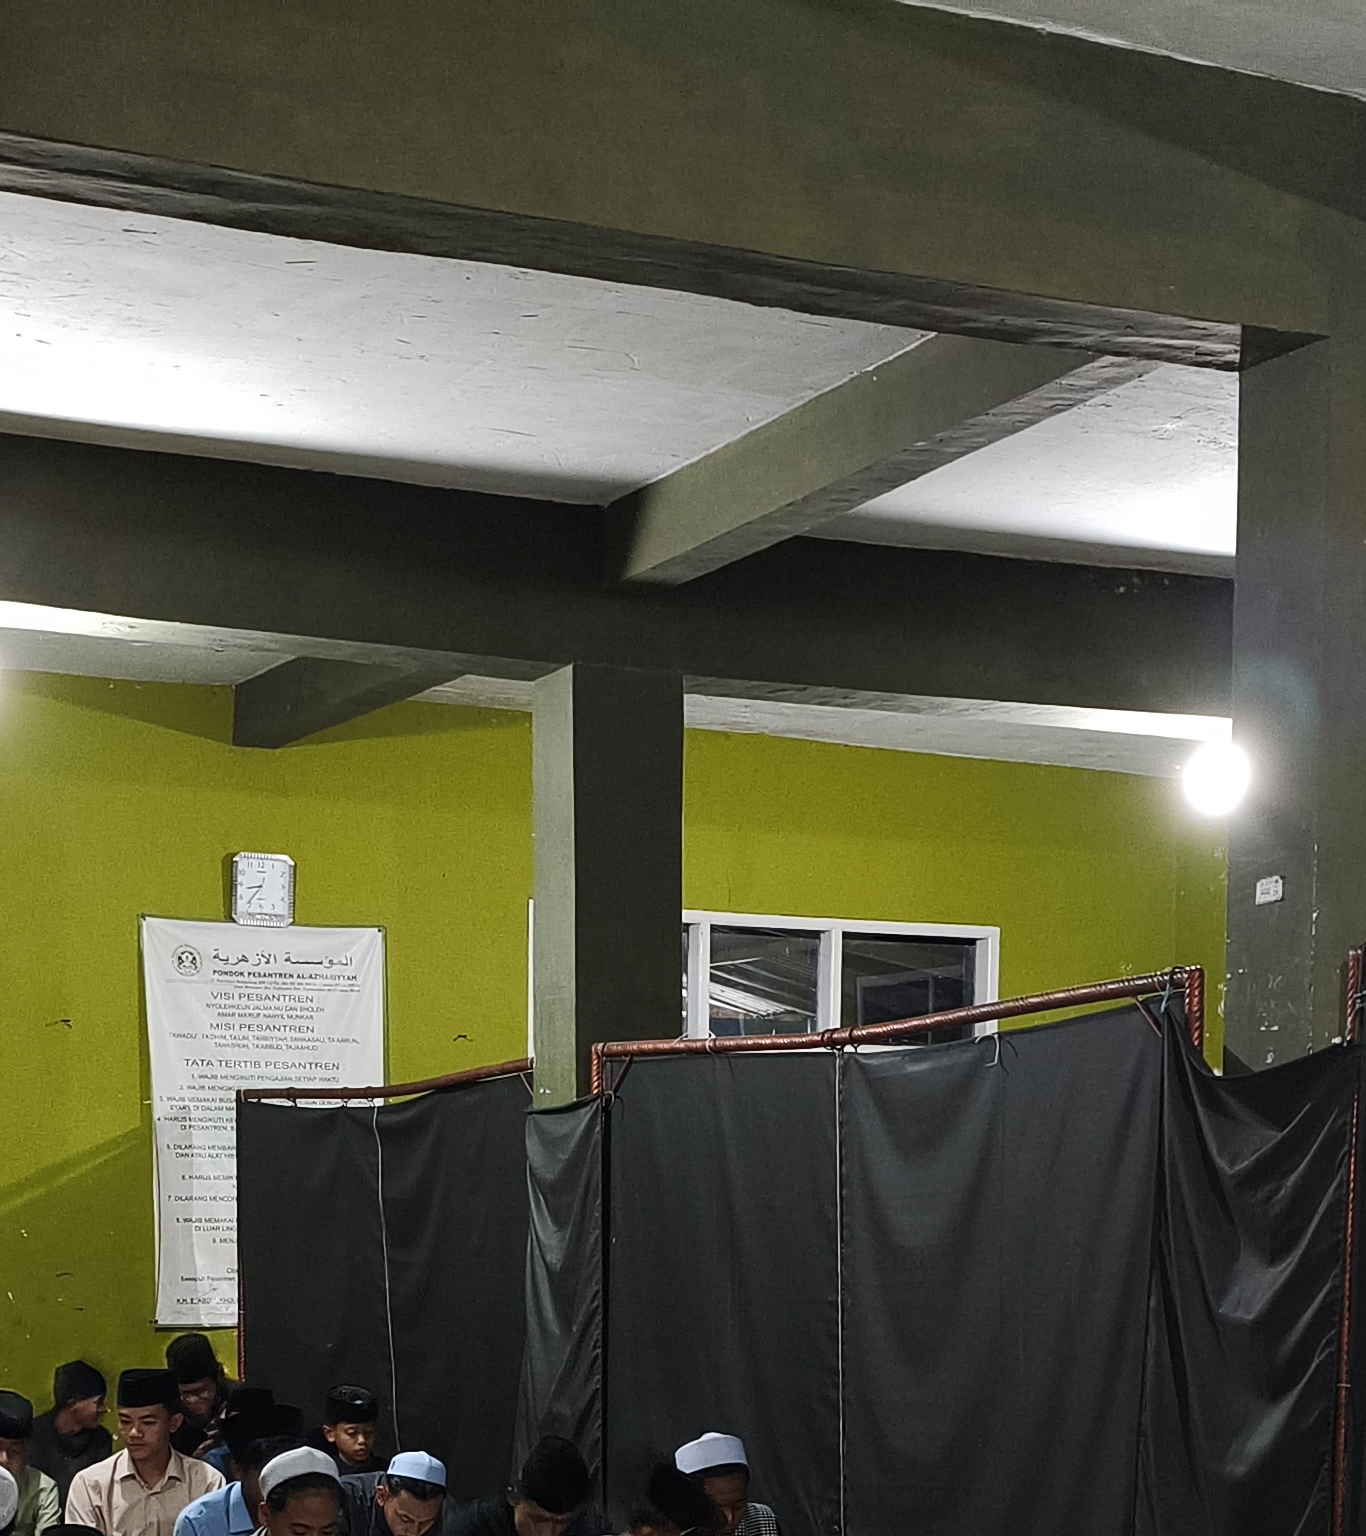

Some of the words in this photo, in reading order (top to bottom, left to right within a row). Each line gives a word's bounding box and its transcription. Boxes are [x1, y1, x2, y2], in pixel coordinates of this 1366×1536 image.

[212, 969, 245, 978] PONDOK
[247, 971, 294, 979] PESANTREN
[210, 991, 235, 1001] VISI
[238, 993, 314, 1004] PESANTREN
[209, 1022, 235, 1031] MISI
[239, 1023, 315, 1034] PESANTREN
[184, 1058, 215, 1068] TATA
[216, 1059, 261, 1069] TERTIB
[265, 1060, 340, 1071] PESANTREN
